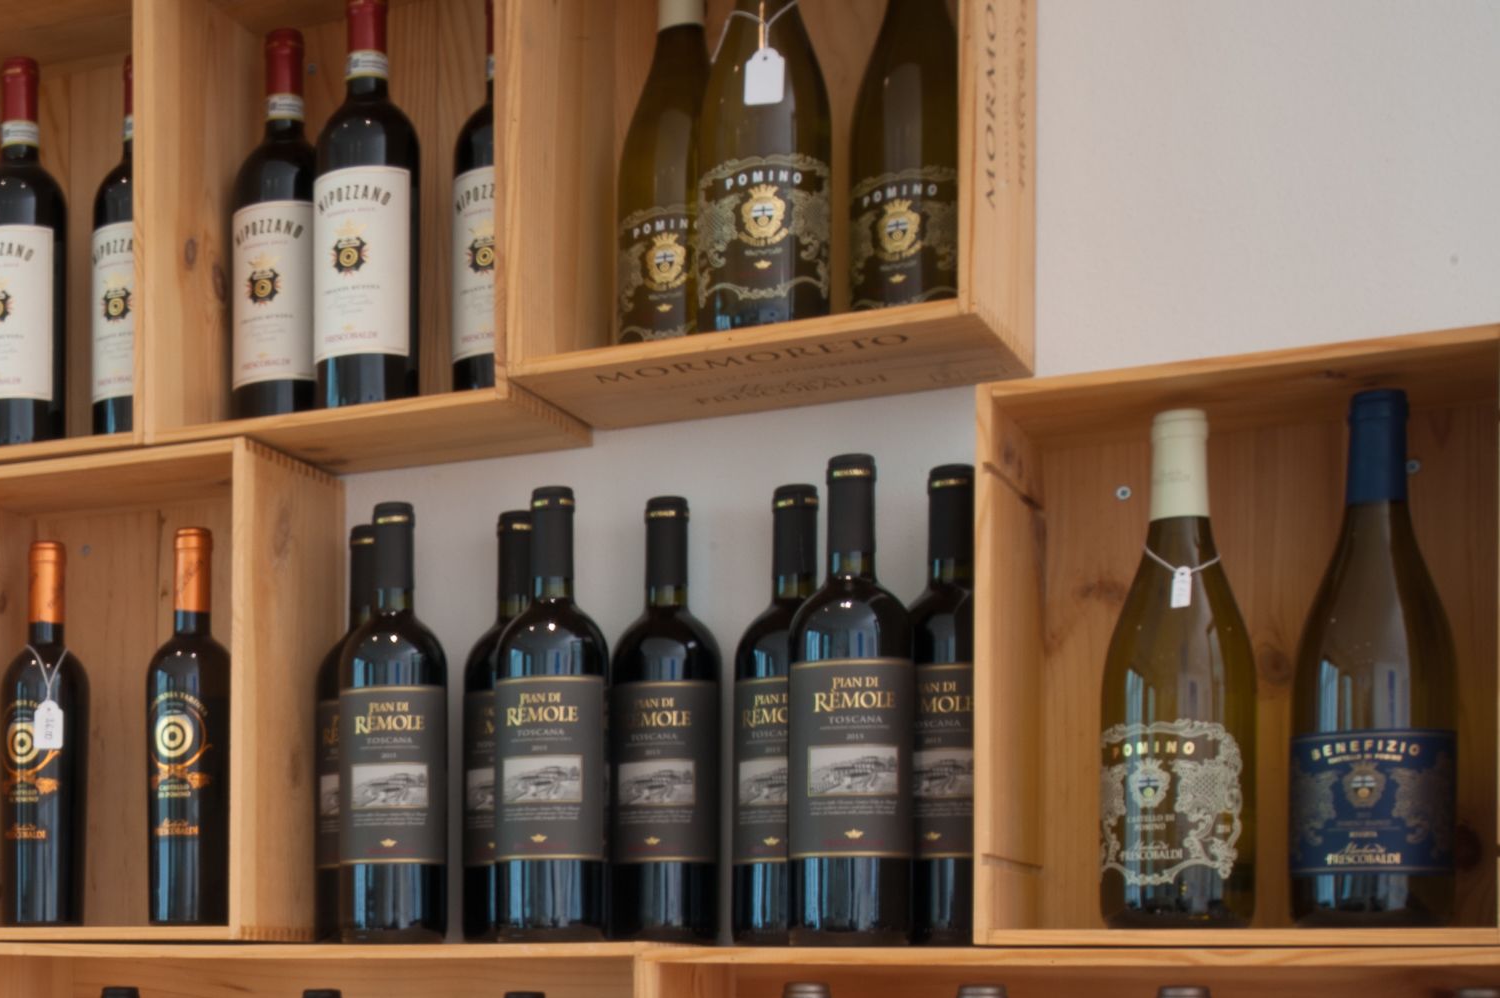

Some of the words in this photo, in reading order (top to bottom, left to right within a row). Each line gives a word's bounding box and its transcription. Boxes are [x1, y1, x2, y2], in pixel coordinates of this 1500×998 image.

[725, 169, 803, 191] POMINO
[317, 183, 393, 216] NIPOZZANO
[455, 183, 495, 215] NIPOZZ
[862, 183, 938, 208] POMINO
[235, 218, 304, 246] NIPOZZANO
[594, 331, 911, 386] MORMORETO
[833, 676, 863, 690] PIAN
[865, 676, 879, 688] DI
[942, 681, 957, 692] DI
[519, 691, 546, 705] PIAN
[548, 691, 562, 704] DI
[661, 697, 675, 708] DI
[813, 689, 896, 713] RÈMOLE
[369, 701, 396, 714] PIAN
[396, 701, 410, 712] DI
[742, 706, 787, 728] RÈMO
[828, 715, 883, 724] TOSCANA
[366, 736, 413, 745] TOSCANA
[517, 728, 565, 737] TOSCANA
[751, 729, 788, 739] TOSCAN
[1112, 740, 1196, 759] POMINO
[1310, 738, 1421, 761] BENEFIZIO
[1325, 852, 1402, 865] FRESCOBALDI
